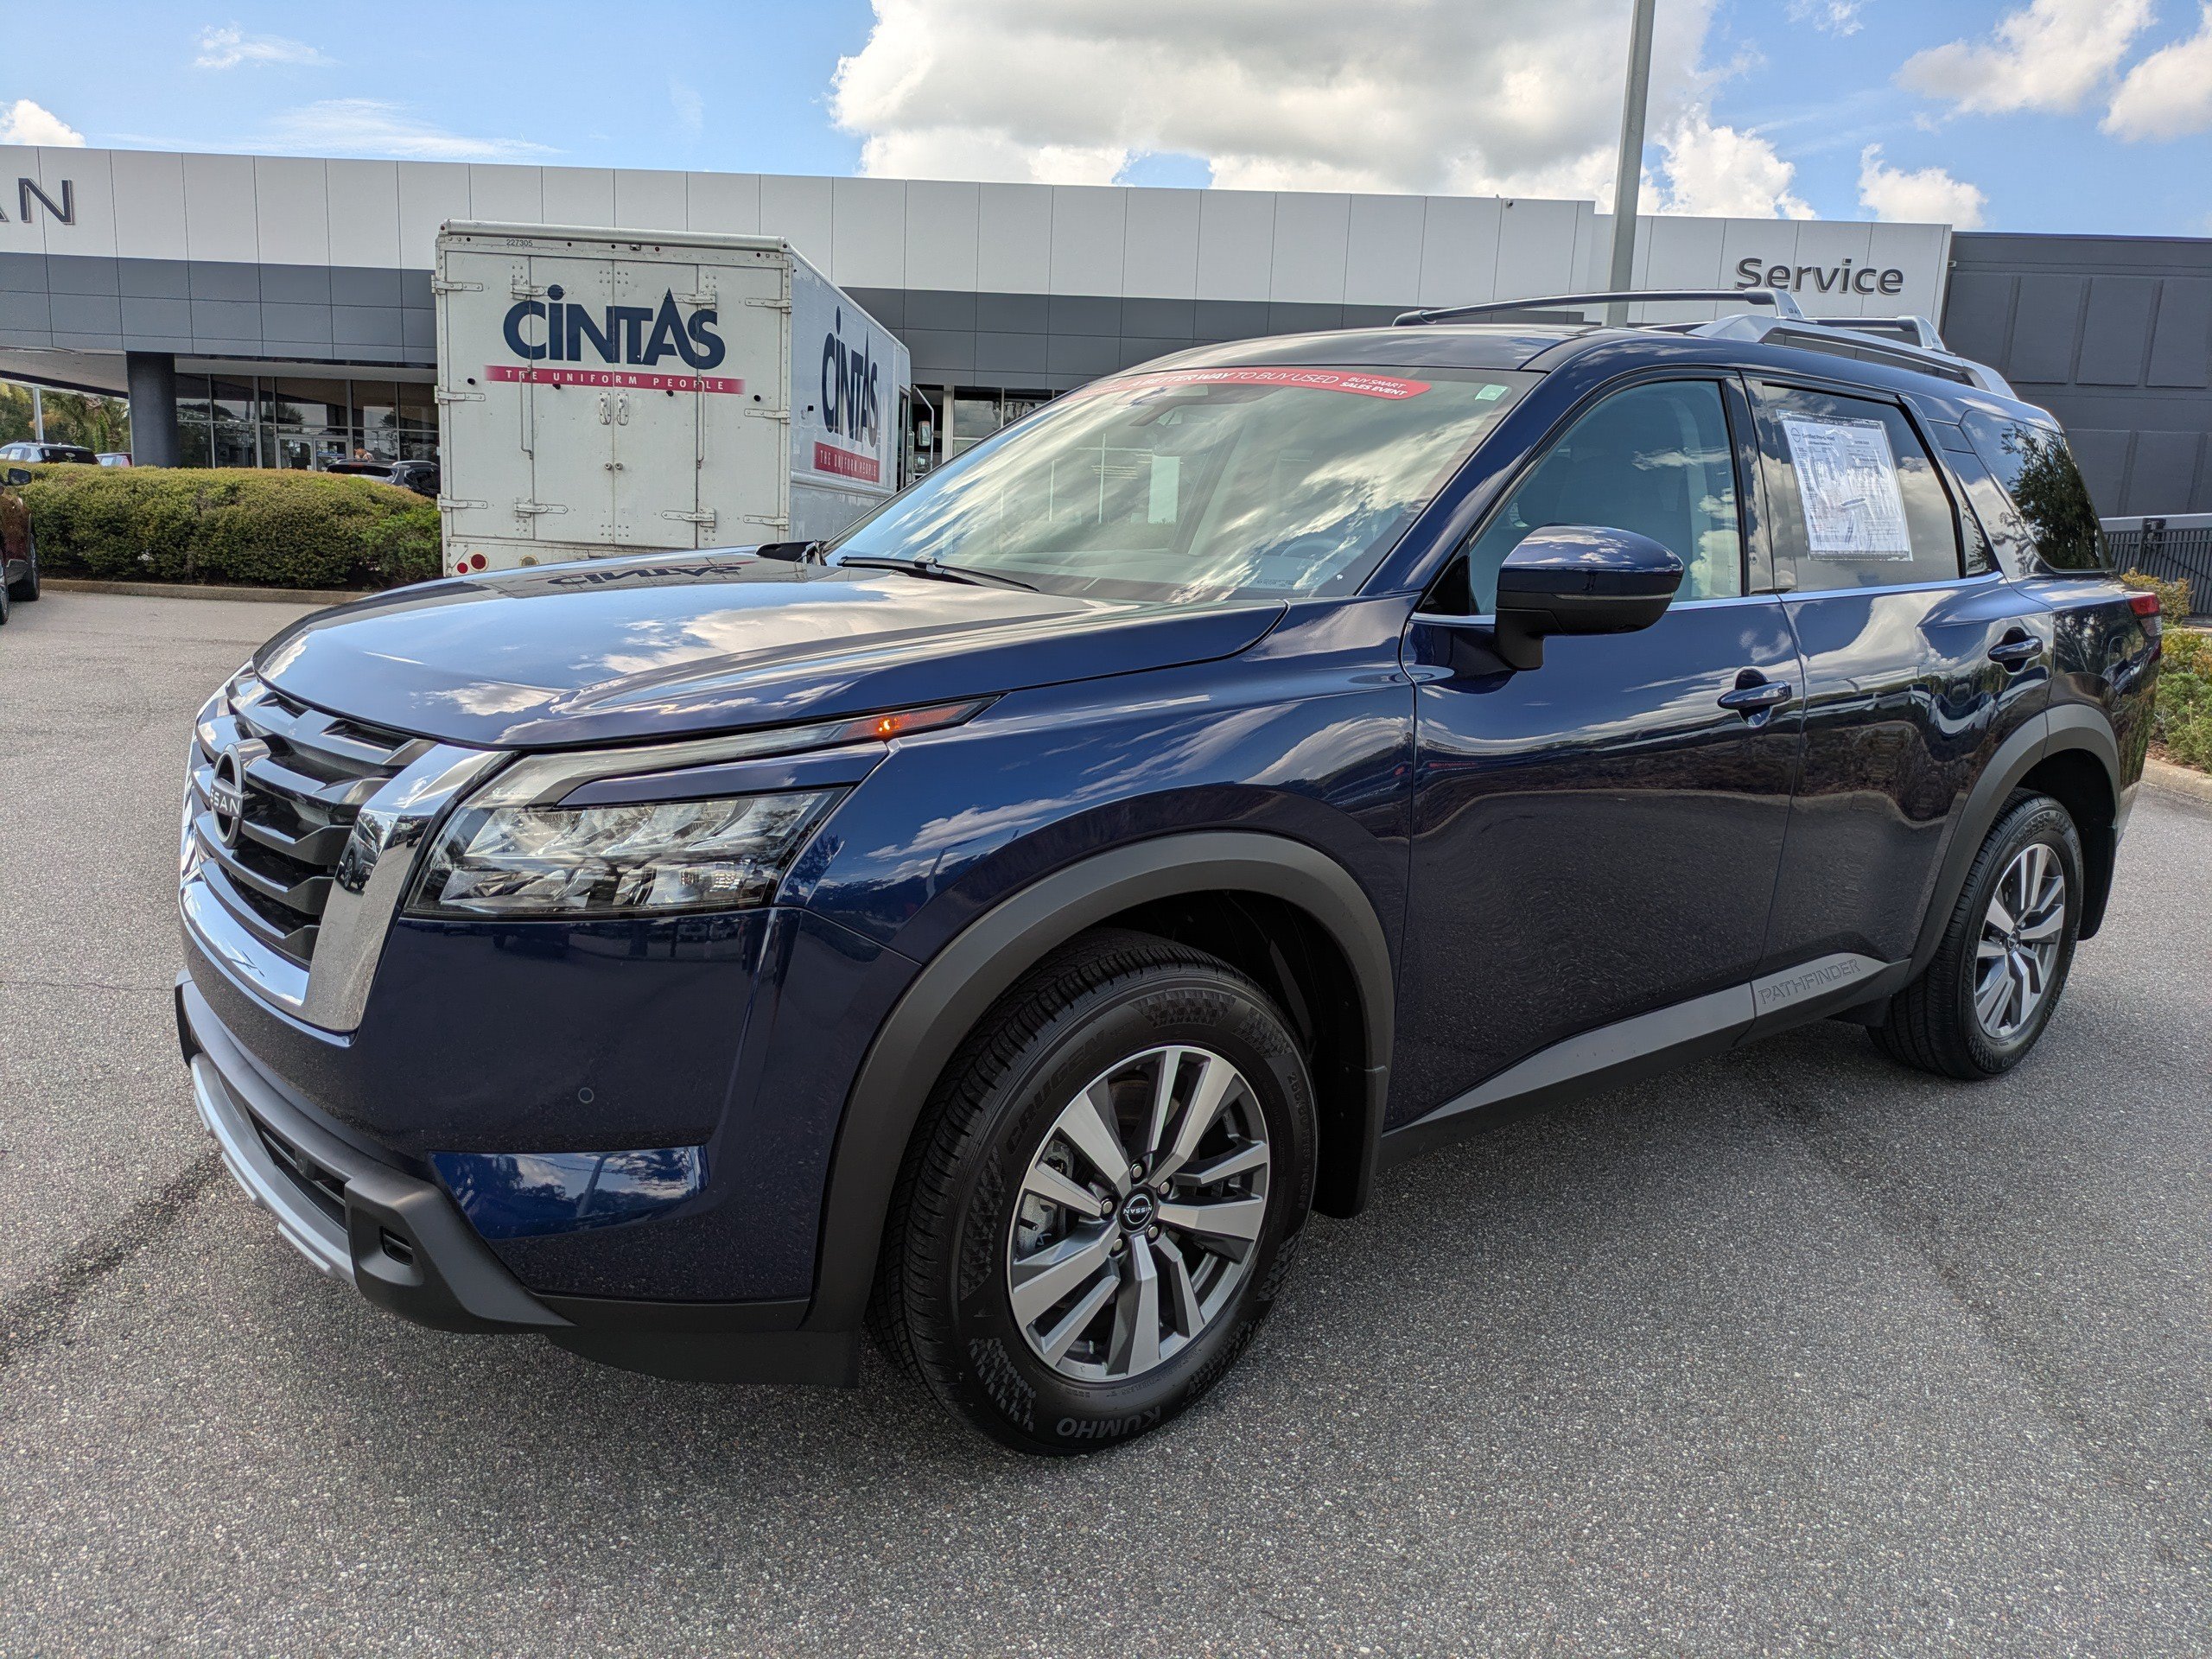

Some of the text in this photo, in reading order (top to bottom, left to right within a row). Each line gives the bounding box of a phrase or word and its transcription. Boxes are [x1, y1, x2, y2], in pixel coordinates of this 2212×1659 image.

[0, 178, 74, 225] N
[506, 238, 533, 247] 227305
[1735, 257, 1904, 295] Service
[503, 284, 726, 370] CINTAS
[505, 370, 537, 380] THE
[553, 372, 637, 385] UNIFORM
[822, 305, 879, 448] CINTAS
[1141, 373, 1198, 386] BETTER
[1196, 372, 1235, 380] WAY
[1235, 372, 1257, 380] TO
[1255, 372, 1289, 380] BUY
[1292, 372, 1339, 385] USED
[1339, 381, 1409, 397] SALES EVENT
[1369, 378, 1408, 390] SMART
[1758, 958, 1861, 1005] PATHFINDER
[1123, 1205, 1153, 1215] NISSAN
[1056, 1405, 1161, 1440] KUMHO
